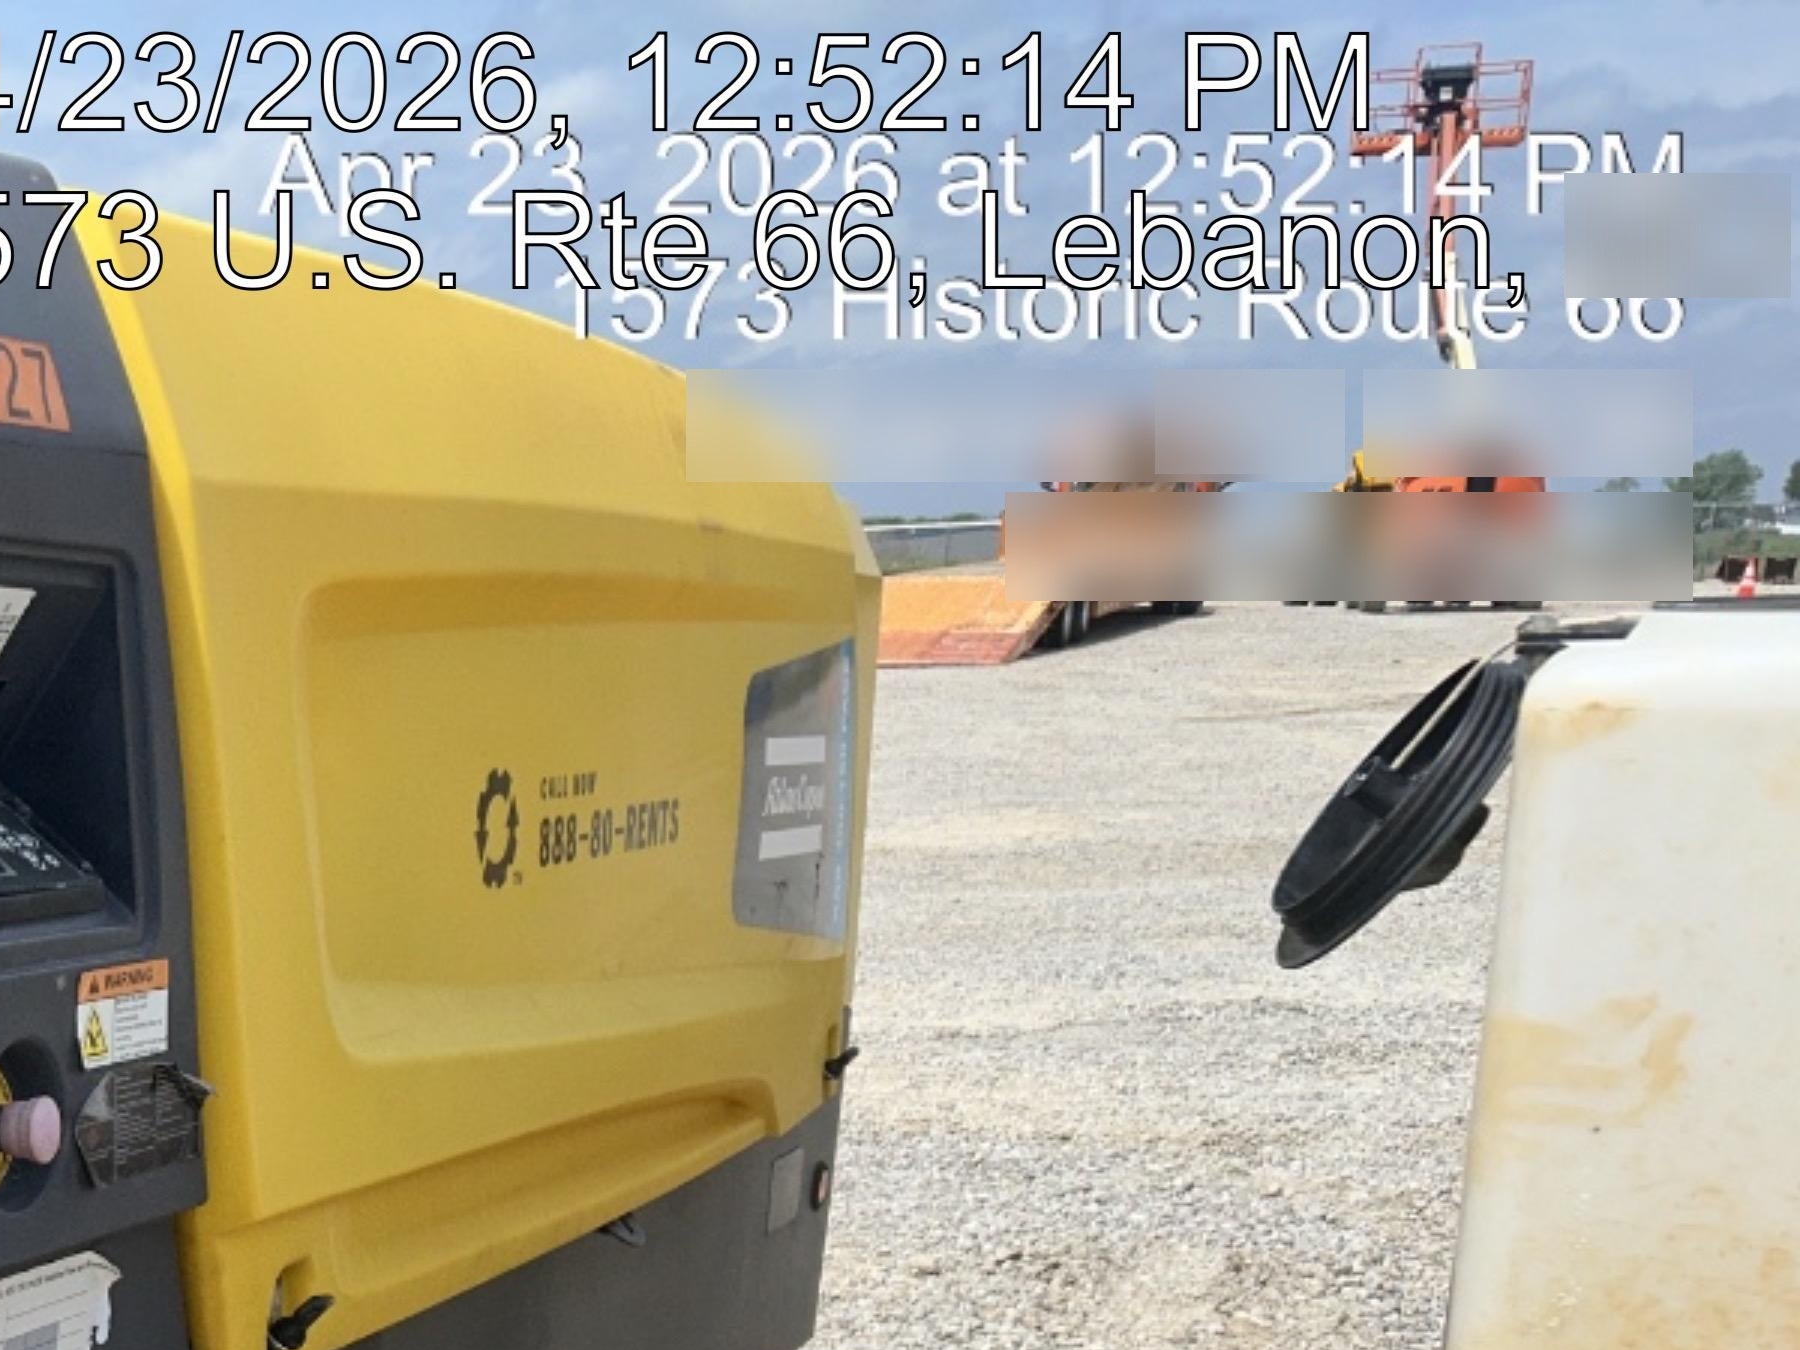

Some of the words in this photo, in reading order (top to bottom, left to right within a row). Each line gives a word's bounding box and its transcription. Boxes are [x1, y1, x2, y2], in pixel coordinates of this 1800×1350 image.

[540, 774, 569, 800] CALL
[573, 771, 598, 796] NOW
[538, 797, 680, 868] 888-80-RENTS
